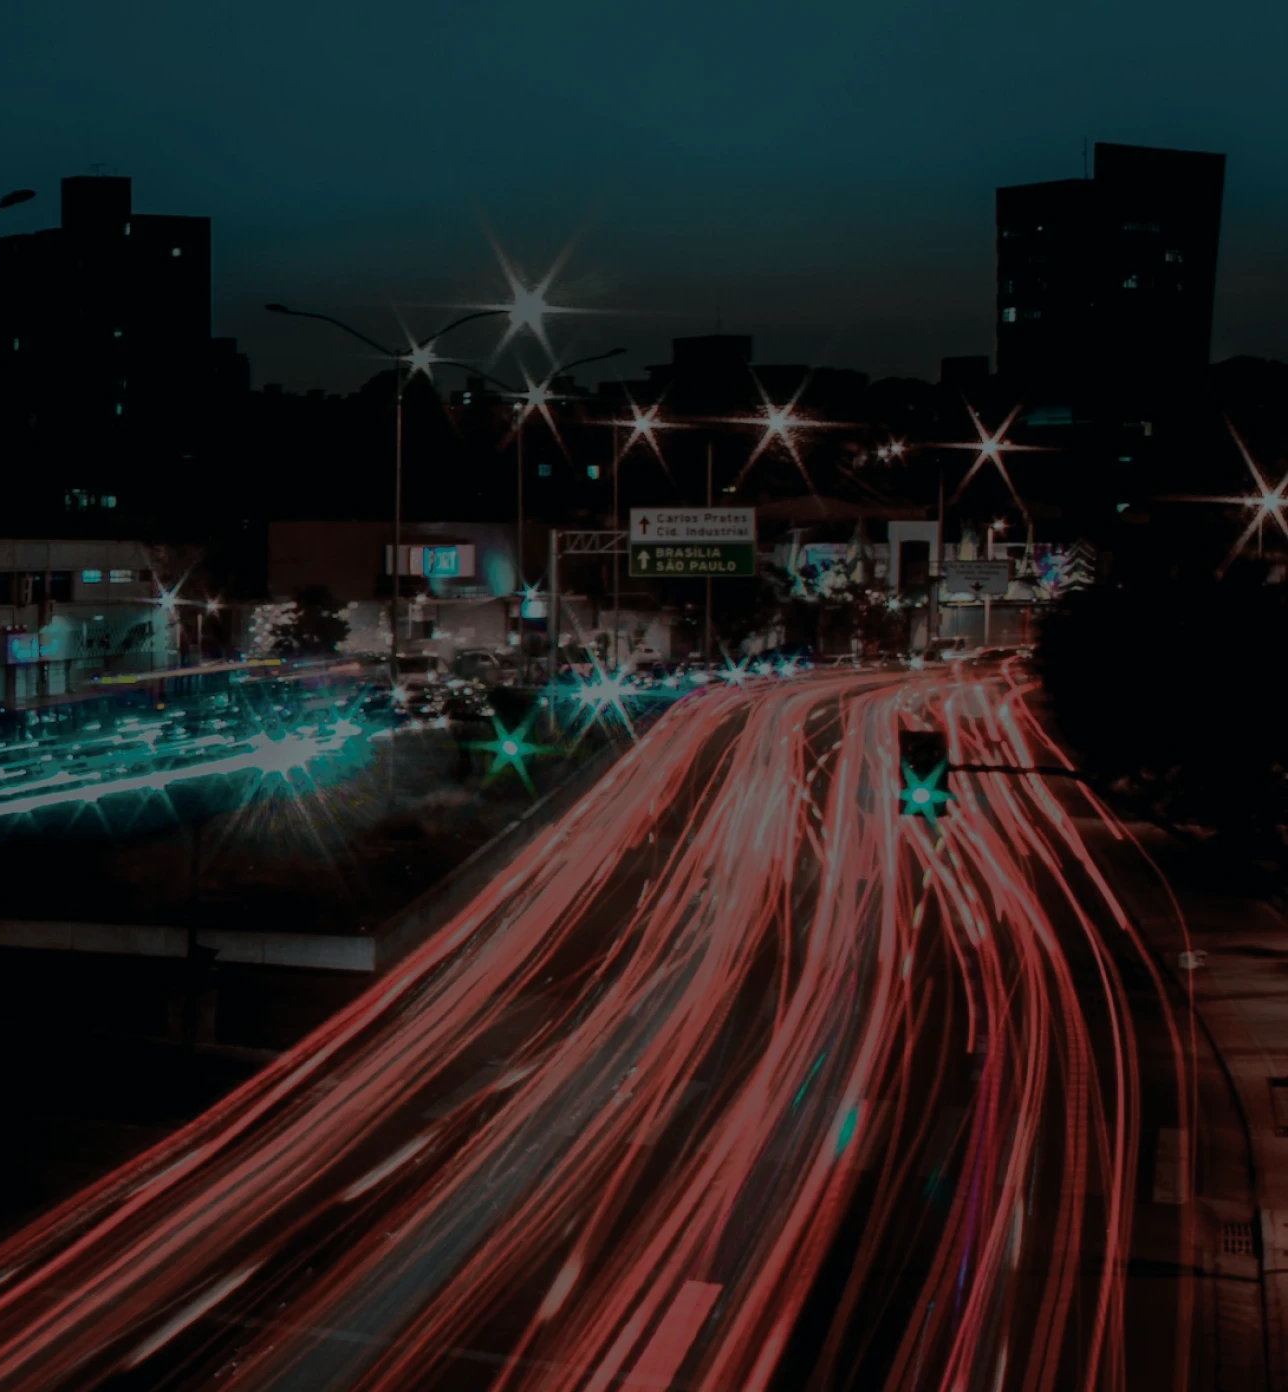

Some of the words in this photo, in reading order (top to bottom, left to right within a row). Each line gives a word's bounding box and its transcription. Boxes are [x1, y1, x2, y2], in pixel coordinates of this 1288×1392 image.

[656, 513, 698, 524] Carlos
[703, 513, 748, 523] Prates
[656, 526, 680, 537] Cid.
[685, 526, 748, 537] Industrial
[655, 545, 722, 558] BRASÍLIA
[655, 558, 685, 572] SÃO
[689, 560, 737, 572] PAULO
